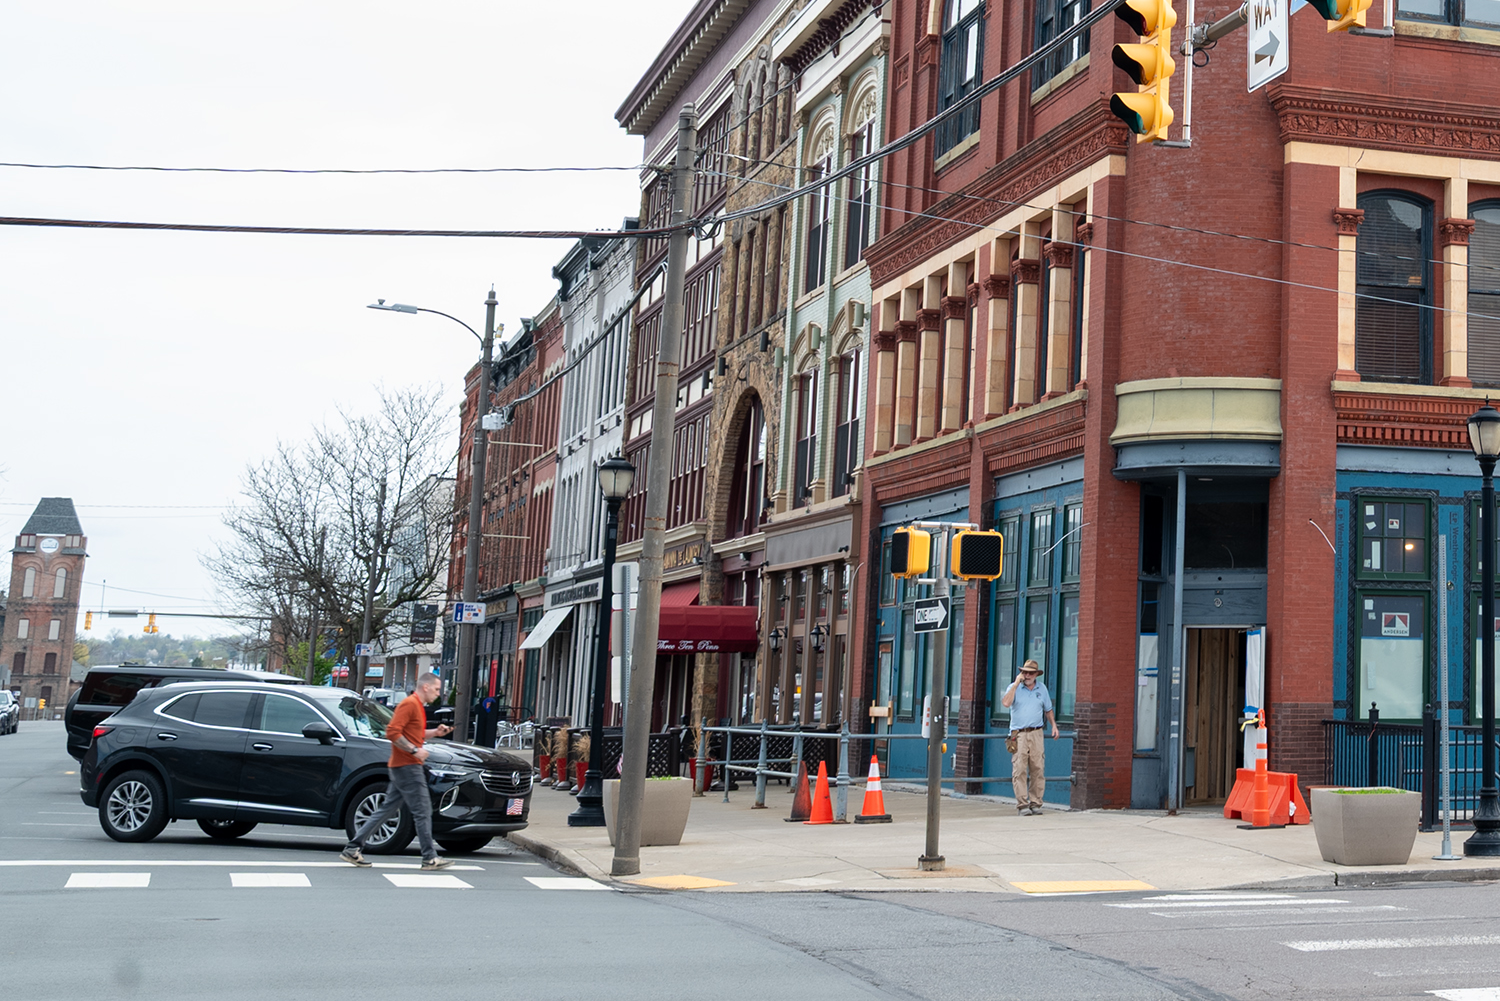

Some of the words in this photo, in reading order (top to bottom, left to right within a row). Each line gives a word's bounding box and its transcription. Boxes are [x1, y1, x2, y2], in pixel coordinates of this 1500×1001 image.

[1452, 525, 1460, 581] WeatherLogic
[917, 609, 928, 622] ONE
[657, 639, 675, 649] Three
[677, 640, 694, 650] Ten
[697, 640, 719, 650] Penn
